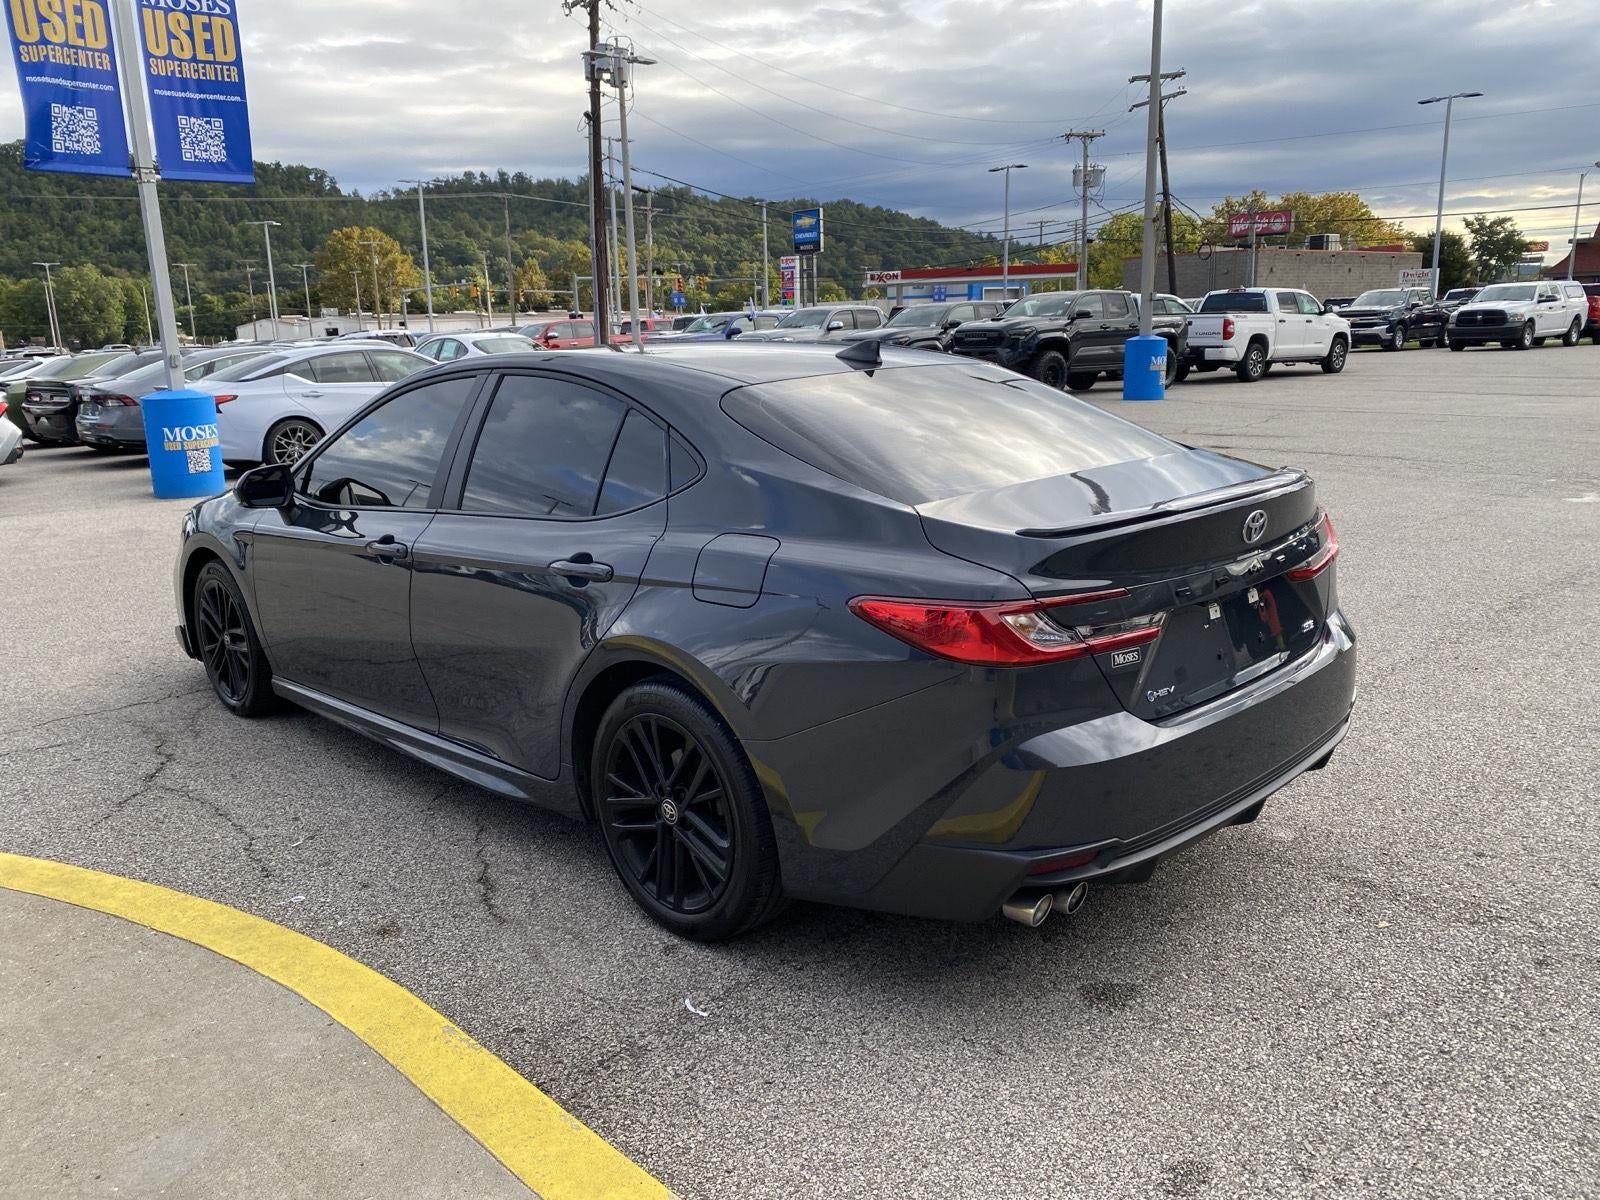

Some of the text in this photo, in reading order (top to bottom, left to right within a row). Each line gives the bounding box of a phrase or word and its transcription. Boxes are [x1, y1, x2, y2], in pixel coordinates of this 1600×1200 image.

[10, 0, 108, 49] USED
[142, 7, 237, 62] USED
[19, 45, 112, 71] SUPERCENTER
[149, 58, 239, 82] SUPERCENTER
[25, 76, 114, 91] mosesusedsupercenter.com
[154, 88, 240, 102] mosesusedsupercenter.com
[869, 272, 899, 283] EXXON
[1114, 651, 1139, 665] MOSES
